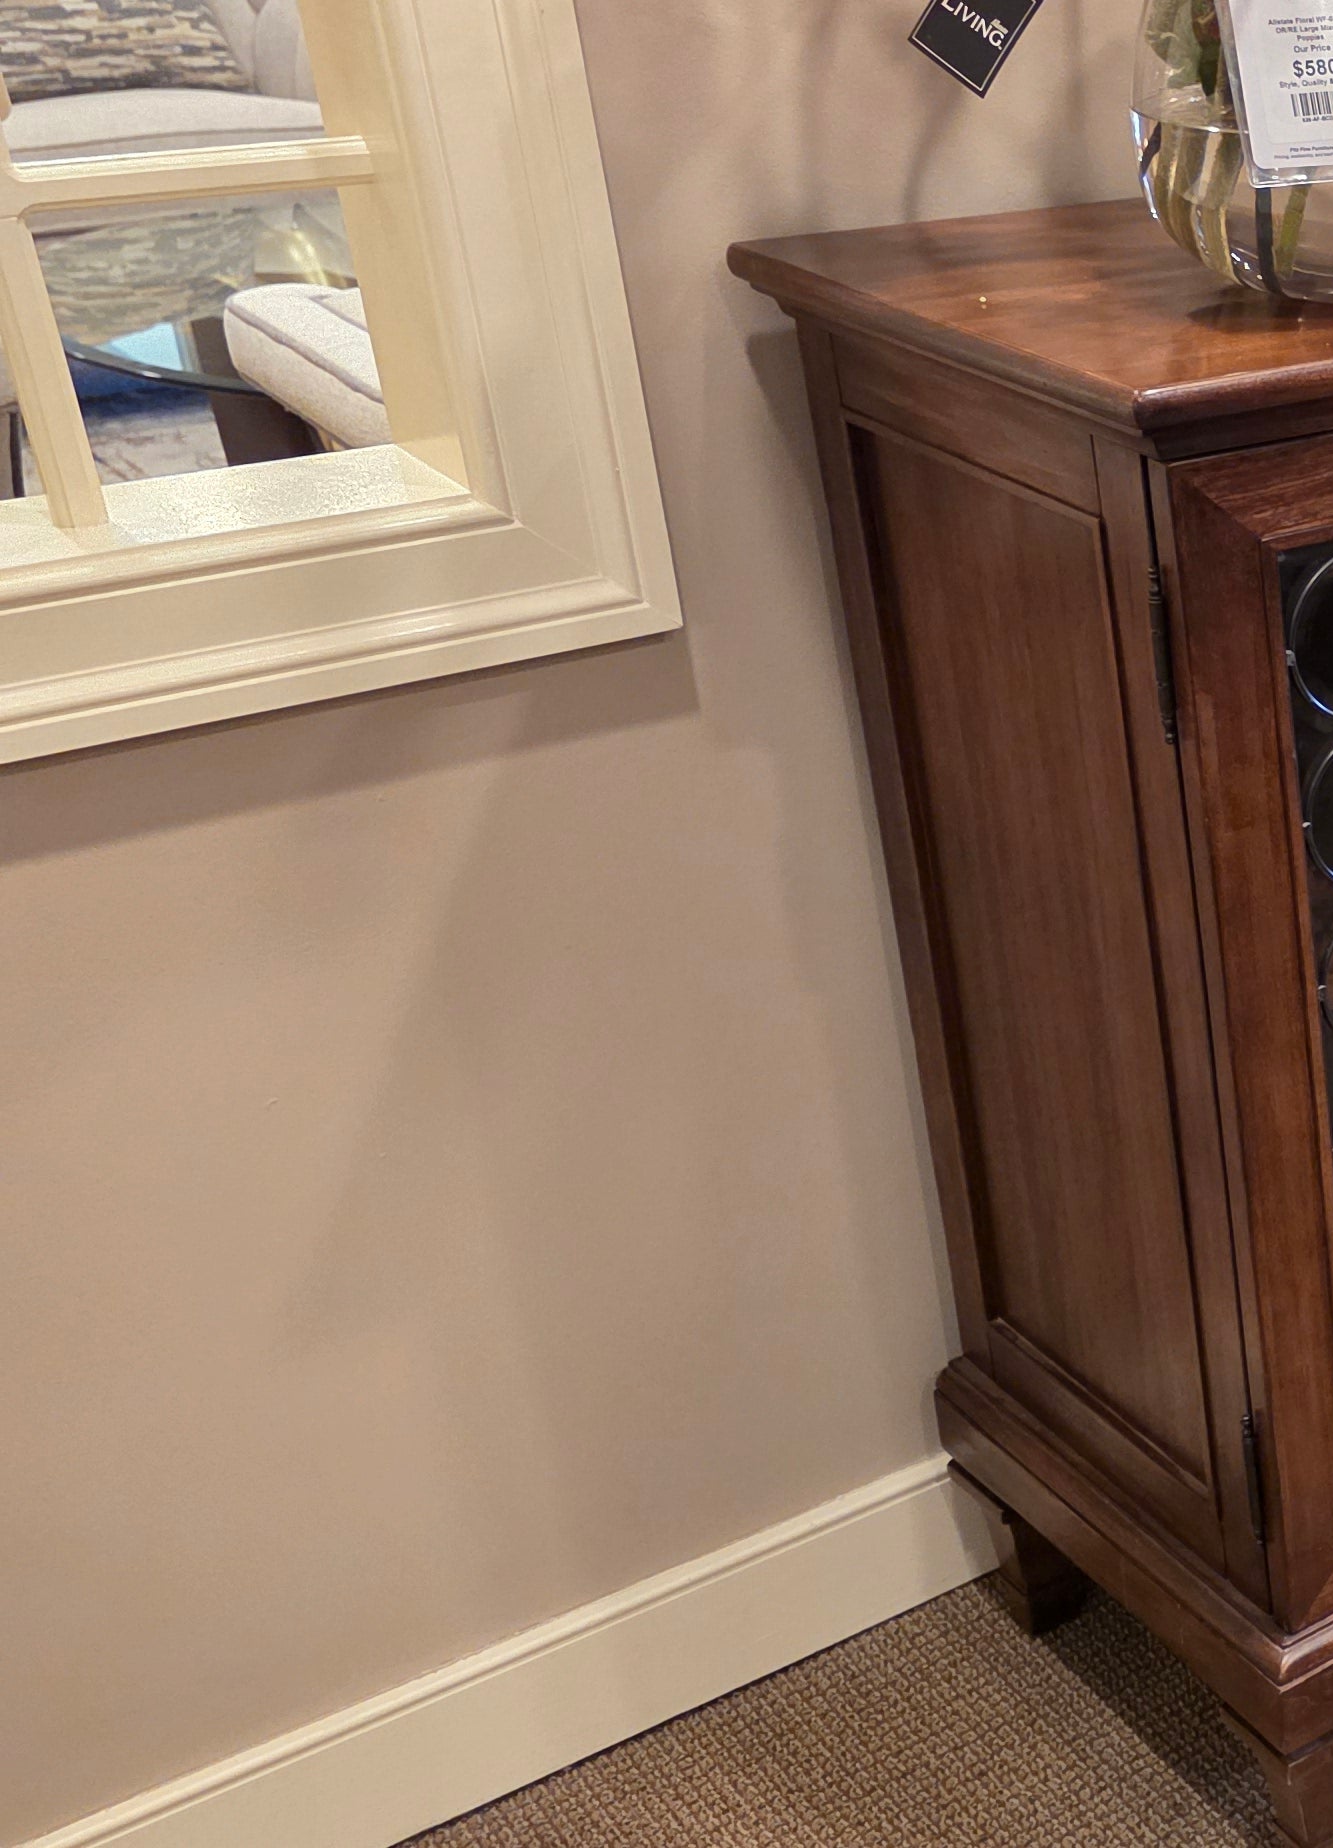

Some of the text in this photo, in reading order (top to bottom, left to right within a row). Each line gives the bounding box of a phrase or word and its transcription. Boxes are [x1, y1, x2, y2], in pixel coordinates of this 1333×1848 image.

[941, 0, 1005, 48] LIVING
[1295, 16, 1315, 24] Floral
[1300, 25, 1319, 33] Large
[1296, 34, 1325, 42] Poppies
[1293, 44, 1331, 53] Our Price
[1279, 80, 1300, 89] Style,
[1301, 78, 1328, 87] Quality
